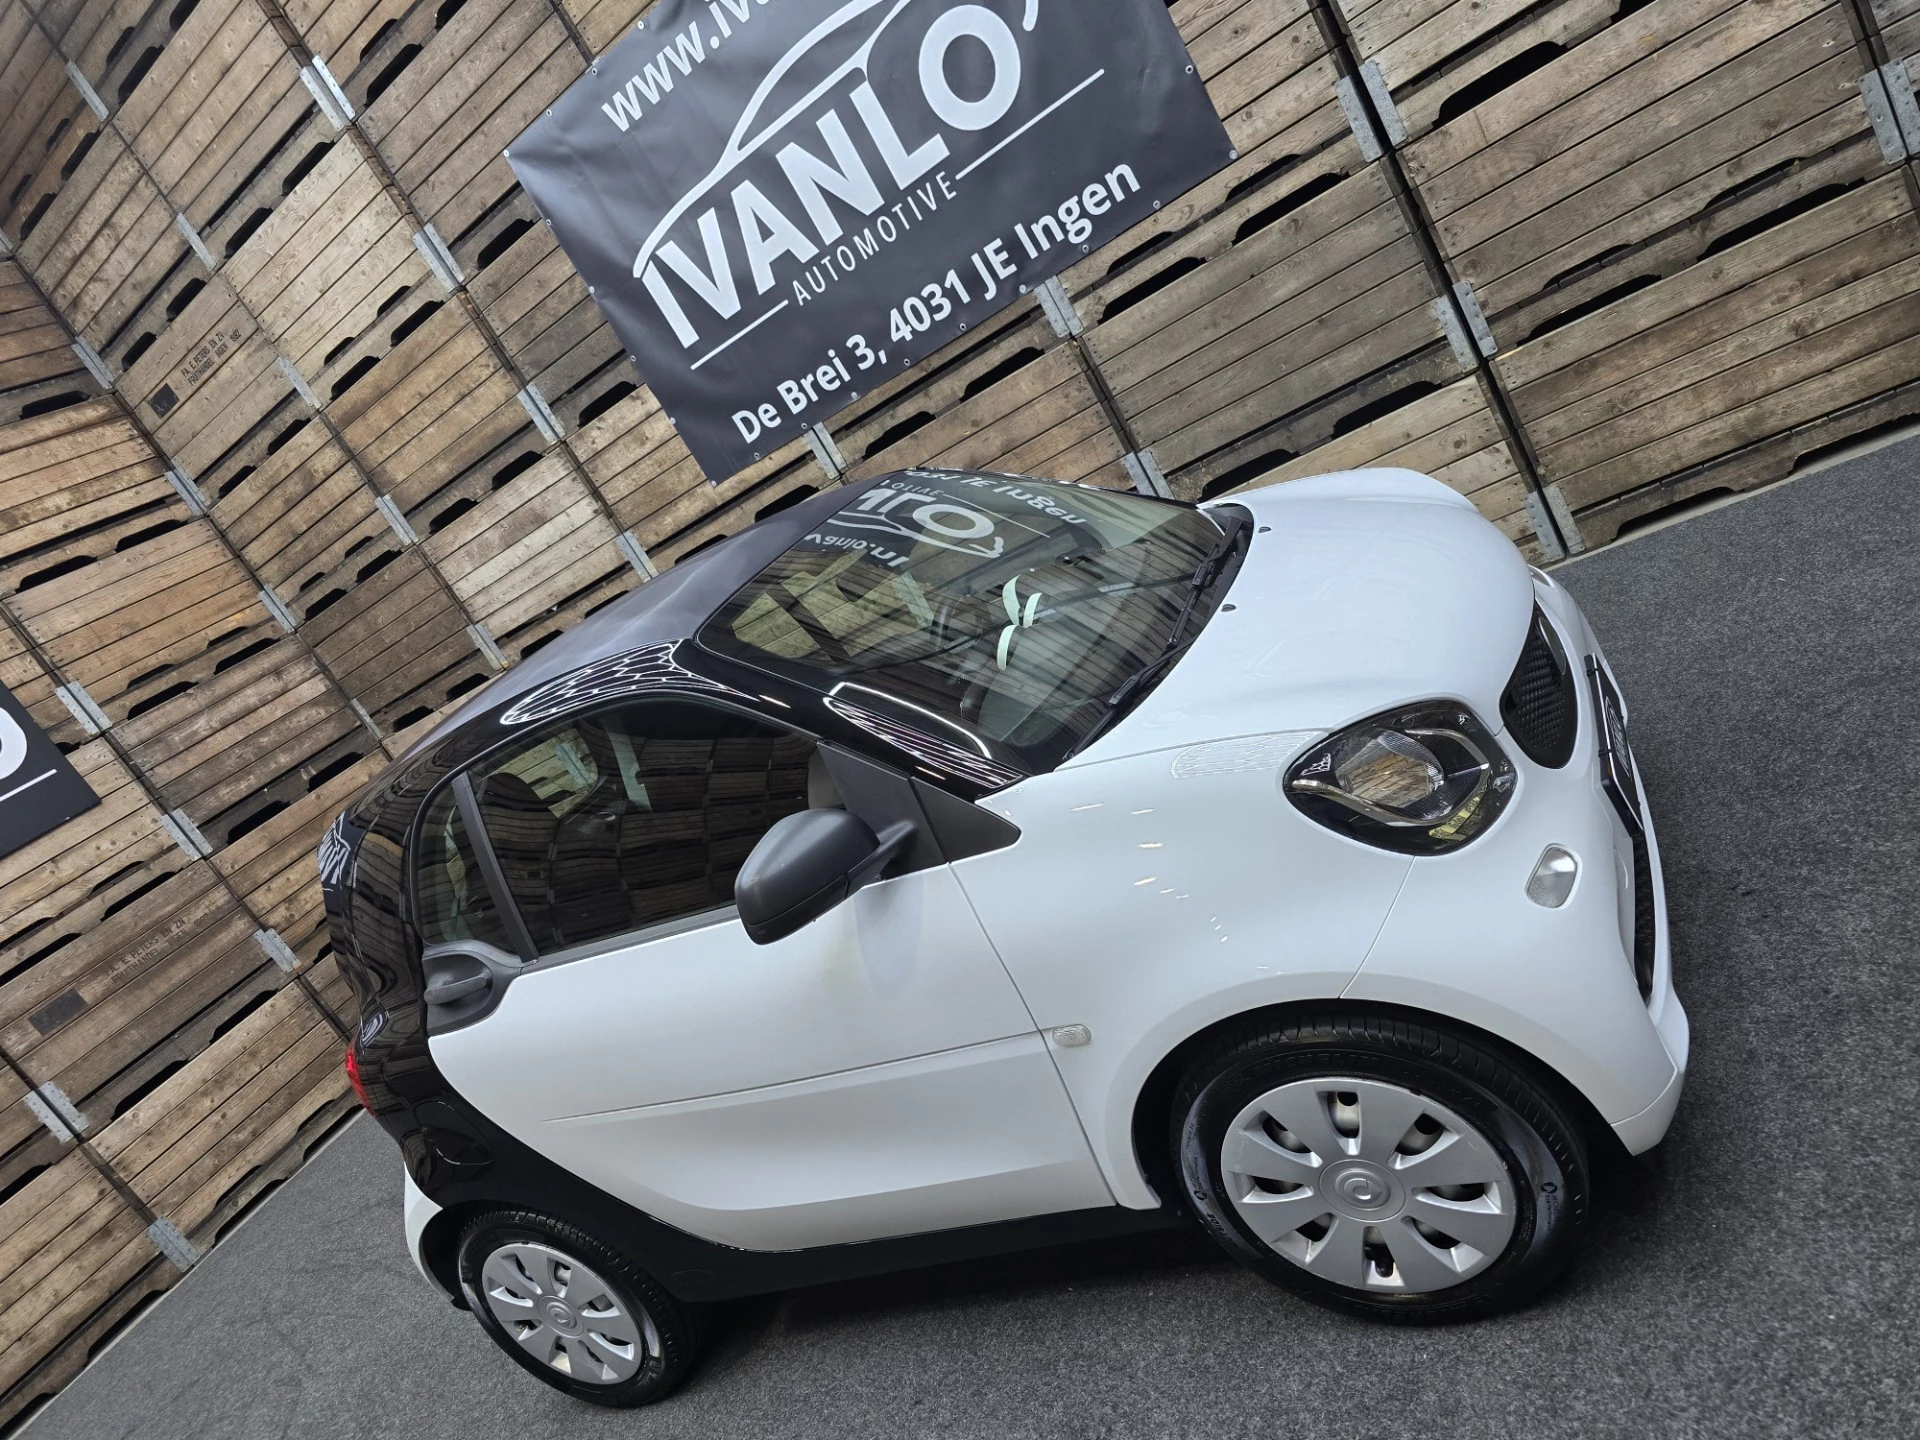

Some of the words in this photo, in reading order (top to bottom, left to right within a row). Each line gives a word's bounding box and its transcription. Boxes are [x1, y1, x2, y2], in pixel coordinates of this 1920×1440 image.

[601, 0, 769, 132] www.iv
[641, 4, 1021, 349] IVANLO
[792, 171, 957, 306] AUTOMOTIVE
[731, 403, 783, 444] De
[777, 350, 851, 414] Brei
[845, 334, 887, 365] 3,
[890, 269, 971, 343] 4031
[971, 237, 1018, 301] JE
[1014, 163, 1141, 260] Ingen
[129, 938, 160, 959] PETERS
